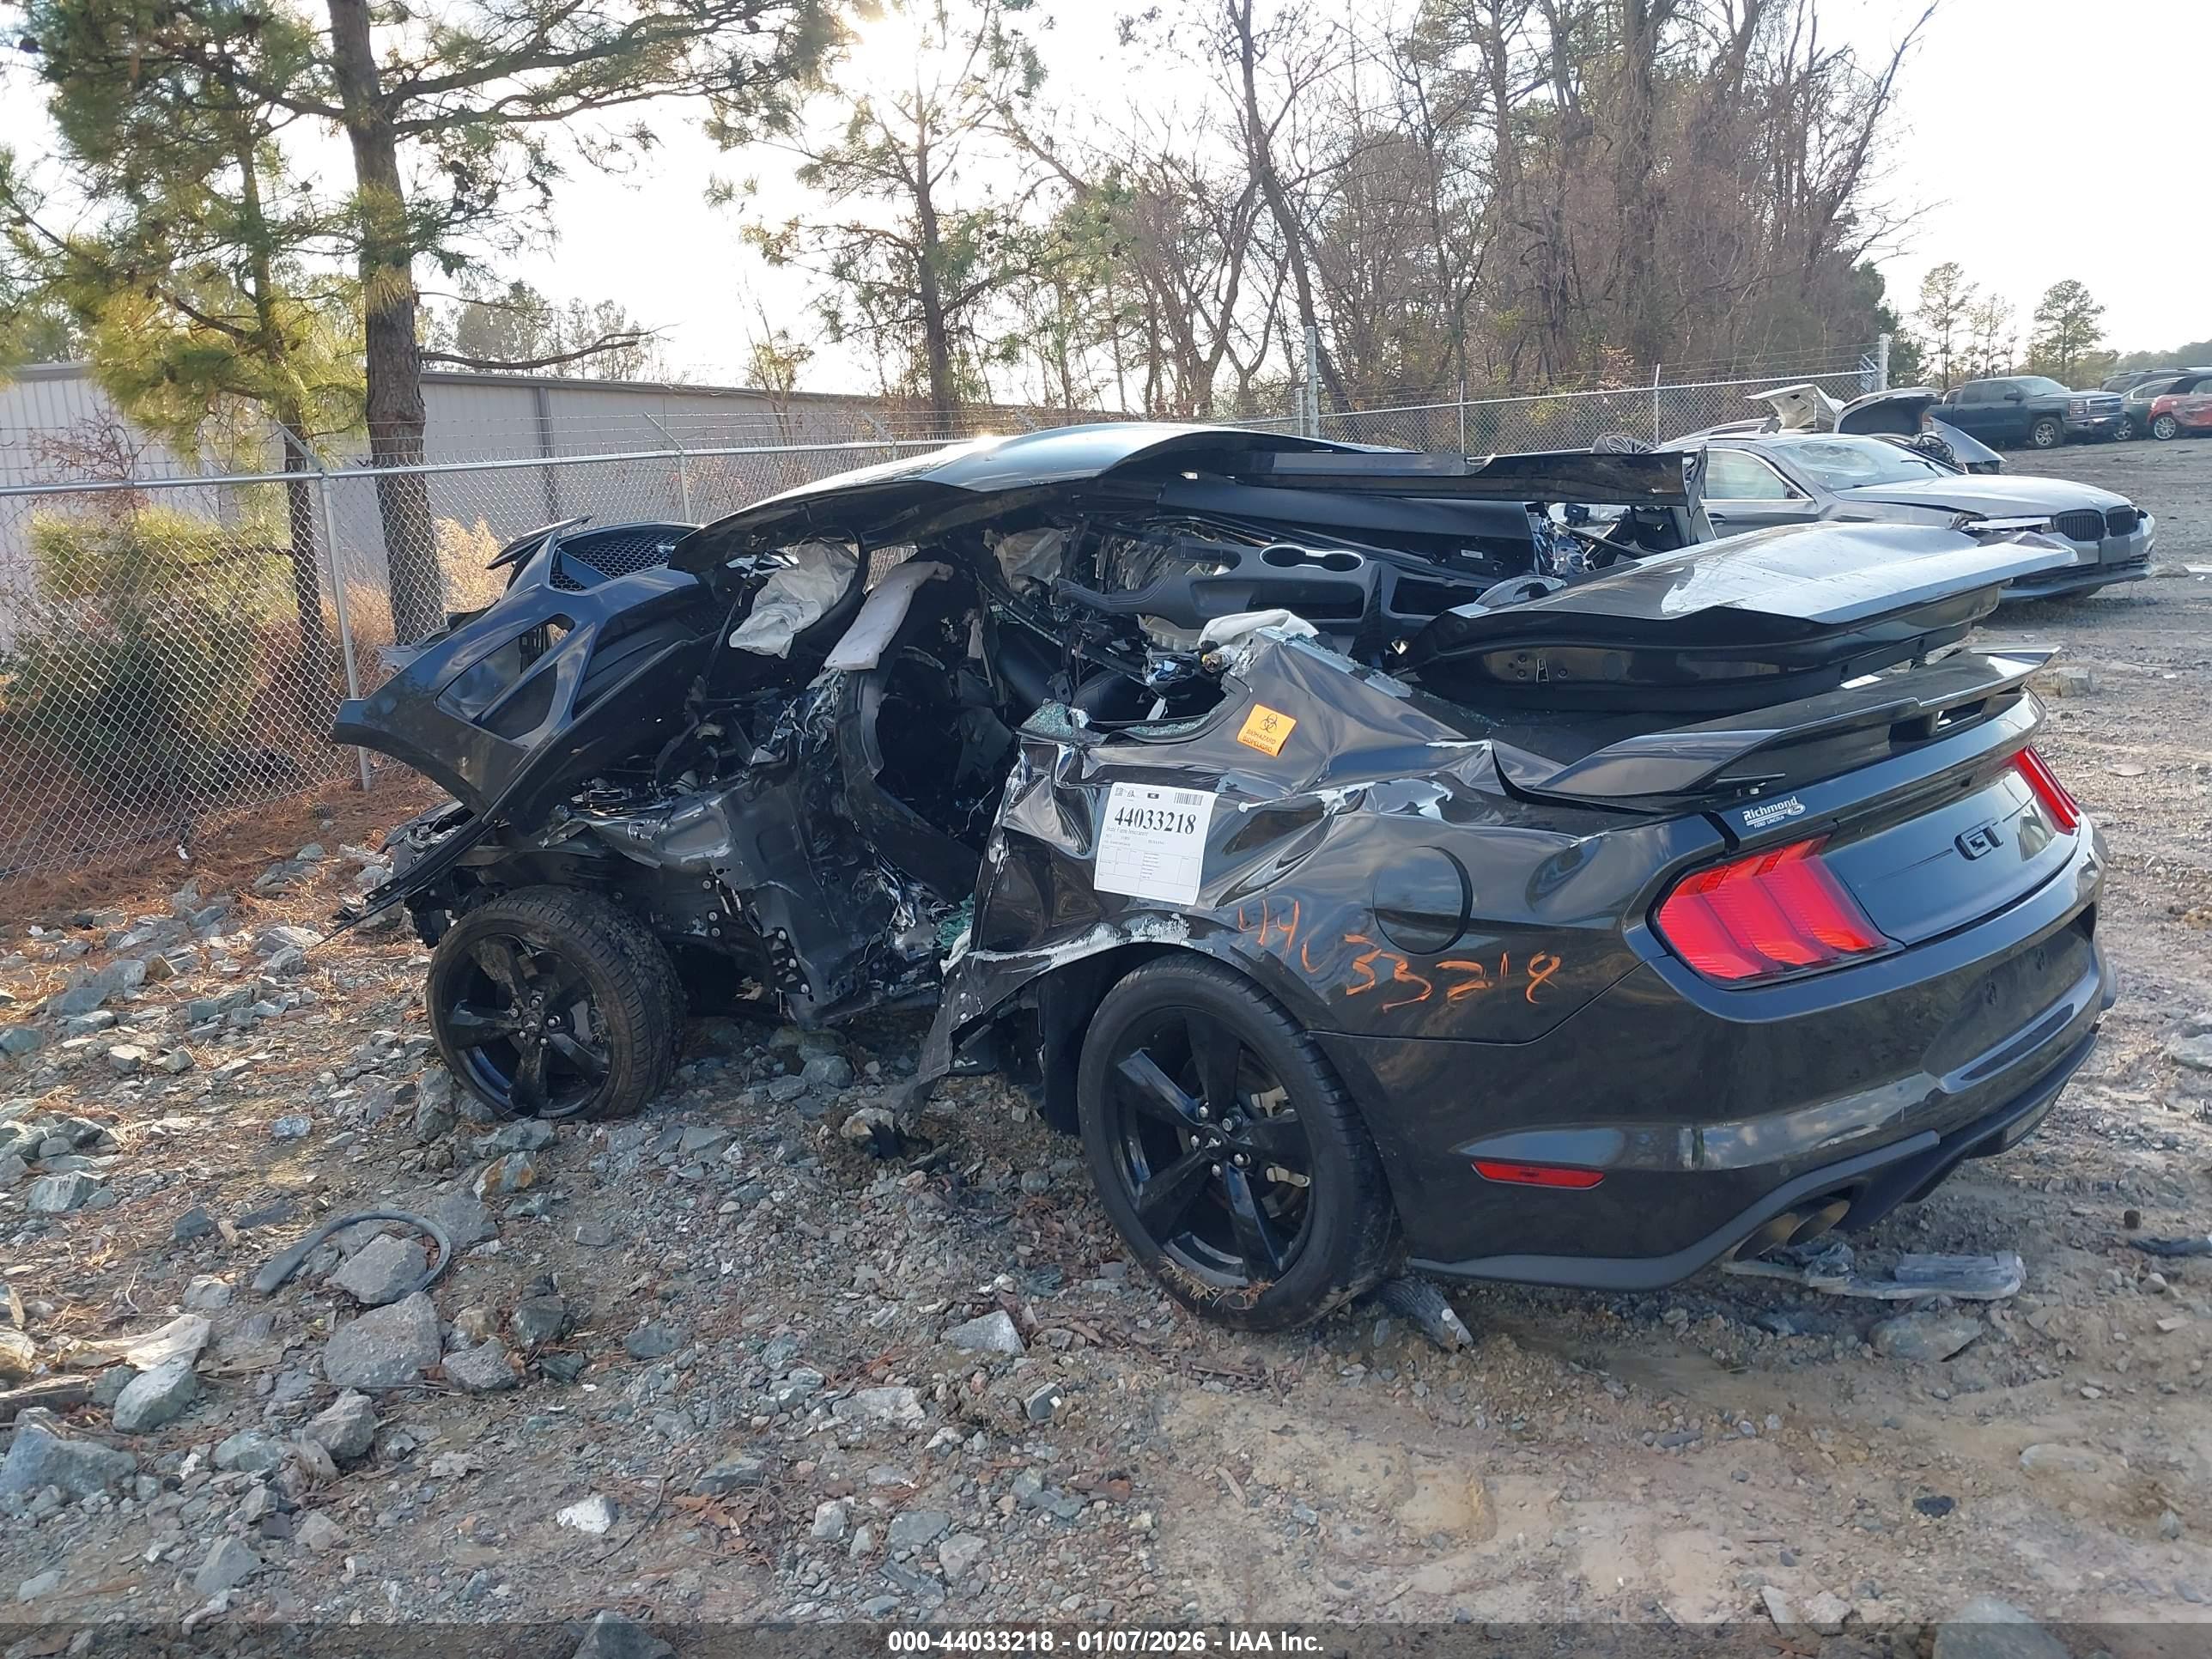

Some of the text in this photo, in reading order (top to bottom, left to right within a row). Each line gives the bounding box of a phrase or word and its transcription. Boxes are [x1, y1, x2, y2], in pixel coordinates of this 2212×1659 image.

[1115, 806, 1197, 835] 44033218
[1742, 795, 1798, 821] Richmond
[1766, 815, 1785, 825] LINCOLN
[1954, 817, 2004, 860] GT
